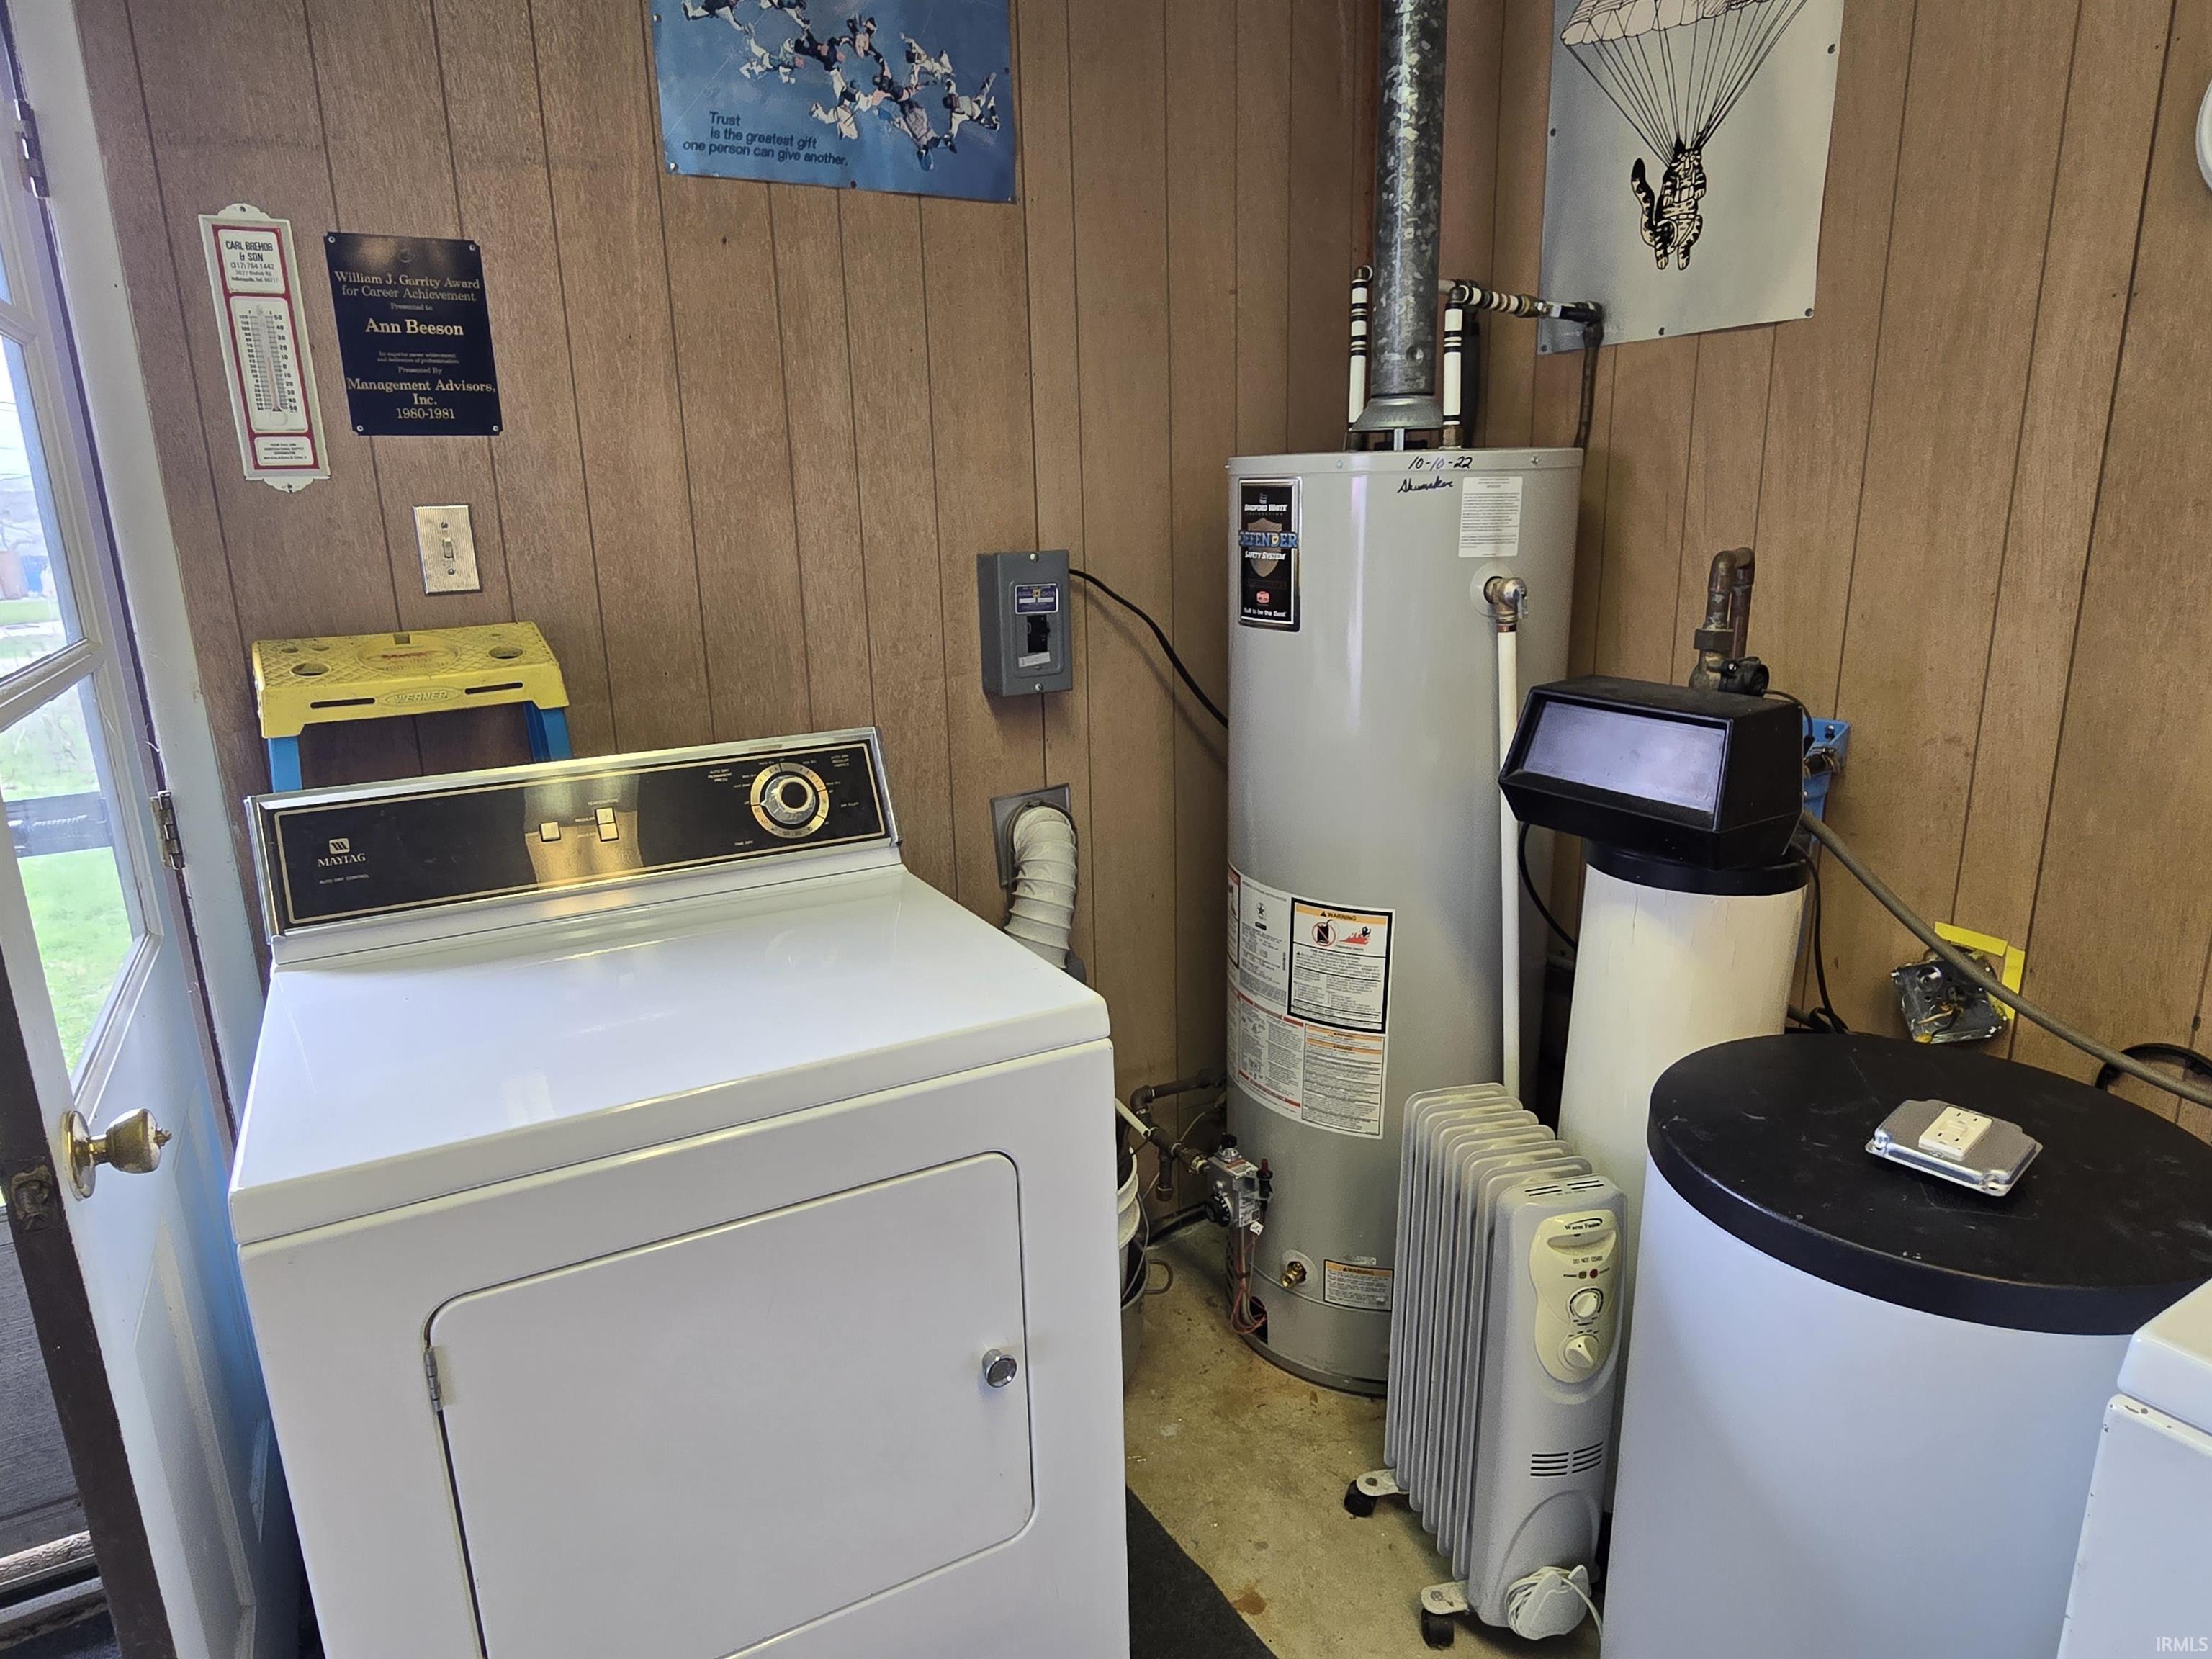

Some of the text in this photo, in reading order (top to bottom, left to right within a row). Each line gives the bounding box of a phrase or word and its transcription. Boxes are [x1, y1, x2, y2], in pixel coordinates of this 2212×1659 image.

[709, 110, 741, 126] Trust
[710, 127, 817, 150] is the greatest gift
[683, 140, 706, 151] one
[709, 143, 750, 155] person
[753, 146, 775, 158] can
[778, 150, 801, 162] give
[225, 240, 274, 251] CARL BREHOB
[248, 253, 264, 262] SON
[334, 271, 480, 289] William J. Garrity Award
[342, 284, 477, 301] for Career Achievement
[365, 318, 464, 336] Ann Beeson
[346, 377, 432, 393] Management
[412, 393, 438, 405] Inc.
[396, 408, 456, 420] 1980-1981
[1408, 456, 1473, 472] 10-10-22
[1239, 531, 1298, 547] DEFENDER
[1262, 552, 1287, 560] SYSTEM
[395, 691, 448, 704] WERNER
[317, 853, 366, 868] MAYTAG
[1328, 912, 1357, 922] WARNING
